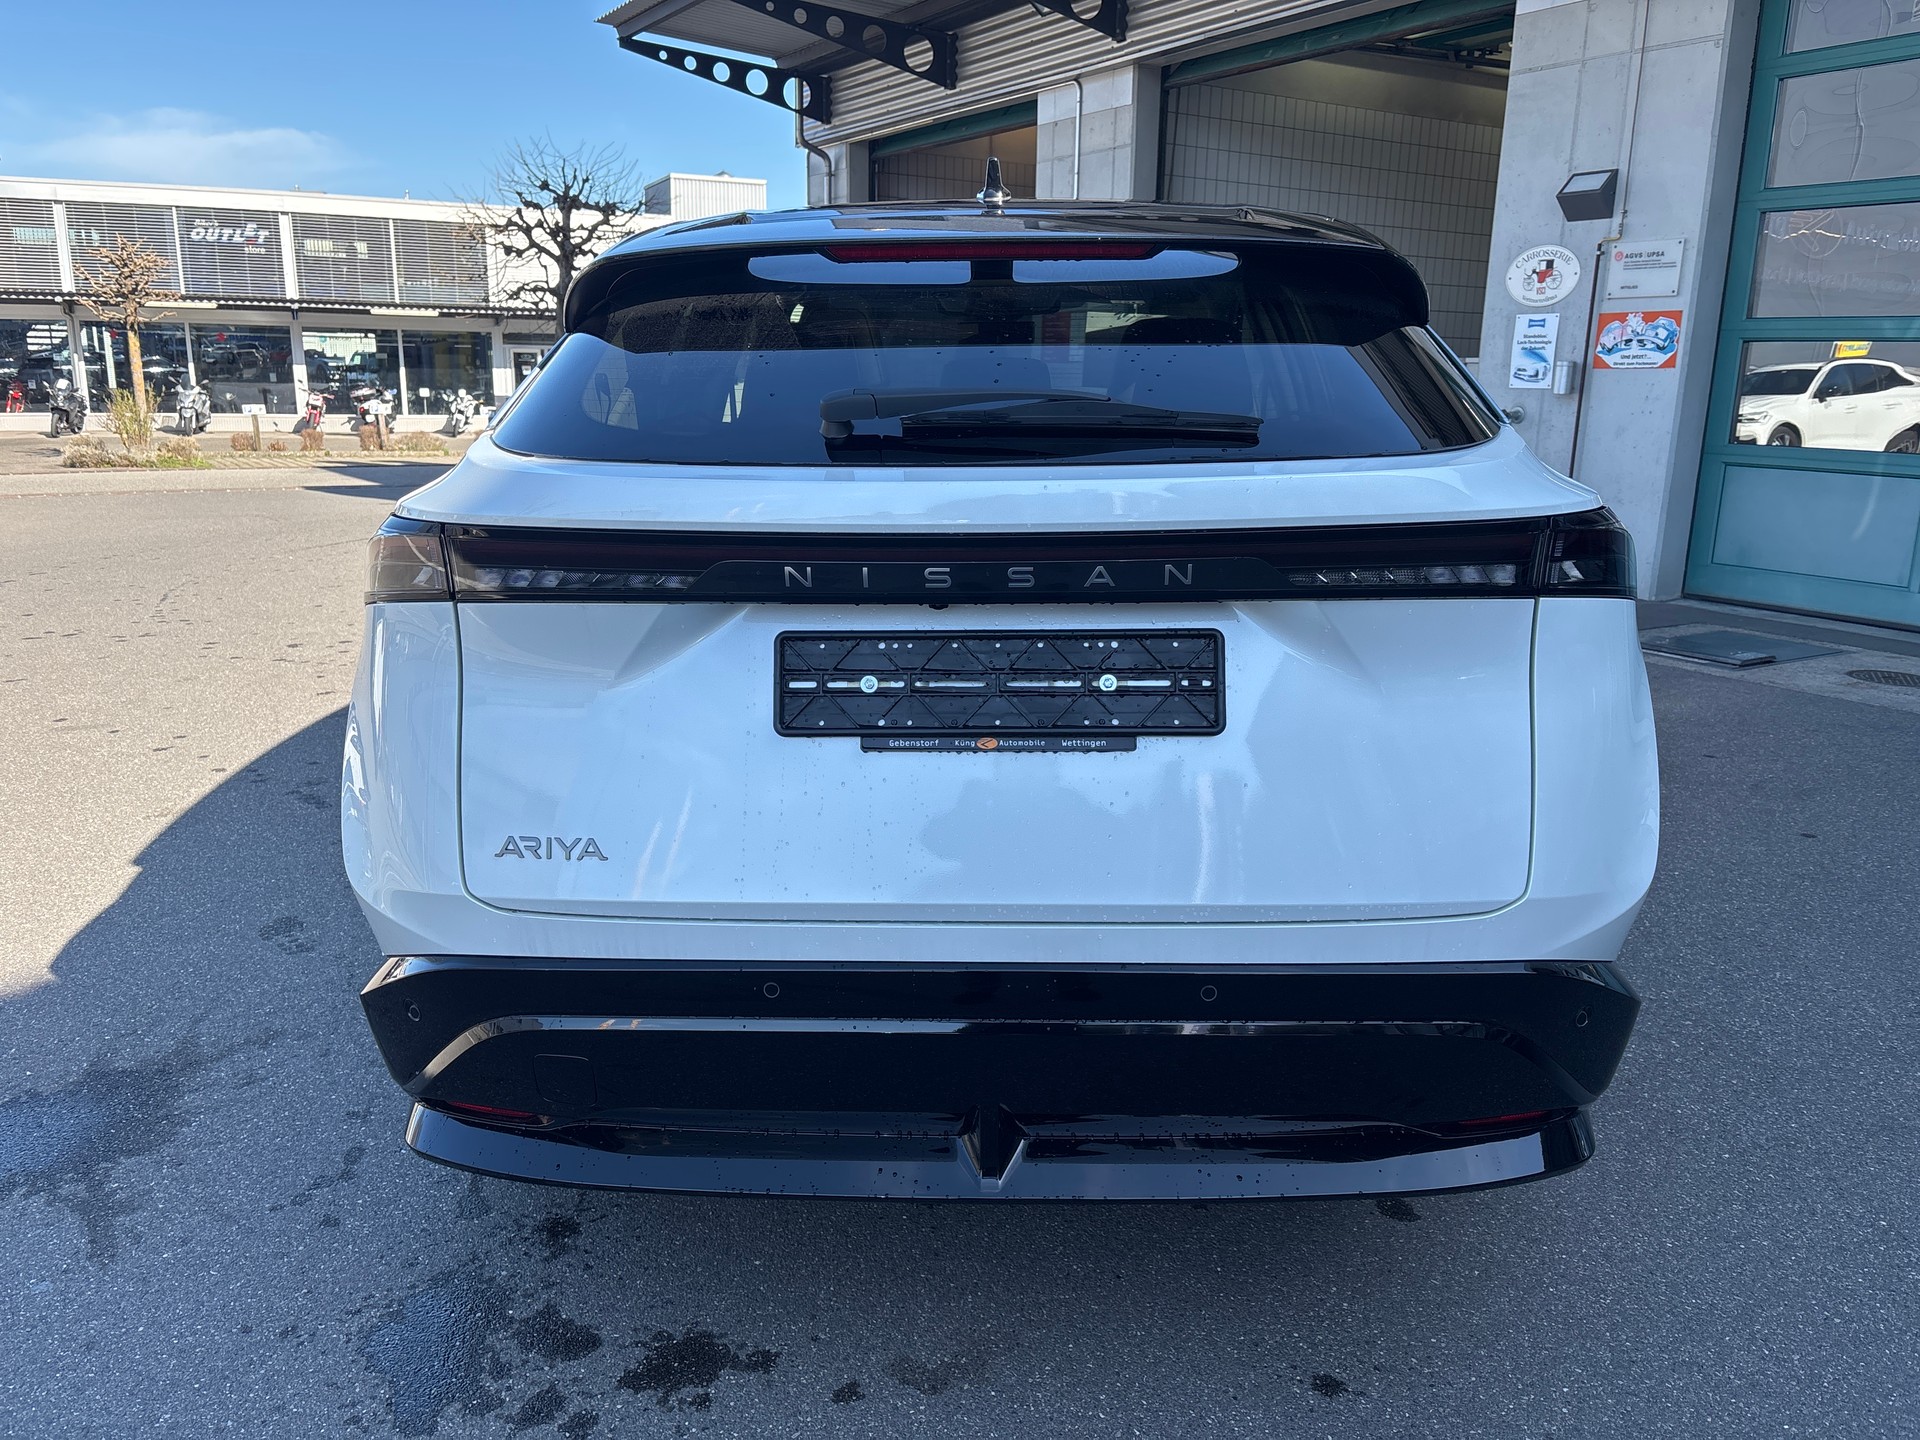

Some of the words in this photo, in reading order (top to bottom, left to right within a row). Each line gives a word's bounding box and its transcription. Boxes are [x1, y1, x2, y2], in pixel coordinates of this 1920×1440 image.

[190, 222, 269, 243] OUTLET
[1515, 249, 1574, 269] CARROSSERIE
[784, 564, 1193, 588] NISSAN
[889, 739, 939, 748] Gebenstorf
[954, 738, 976, 748] Küng
[999, 739, 1046, 747] Automobile
[1061, 739, 1107, 748] Wettingen
[494, 835, 609, 861] ARIYA
